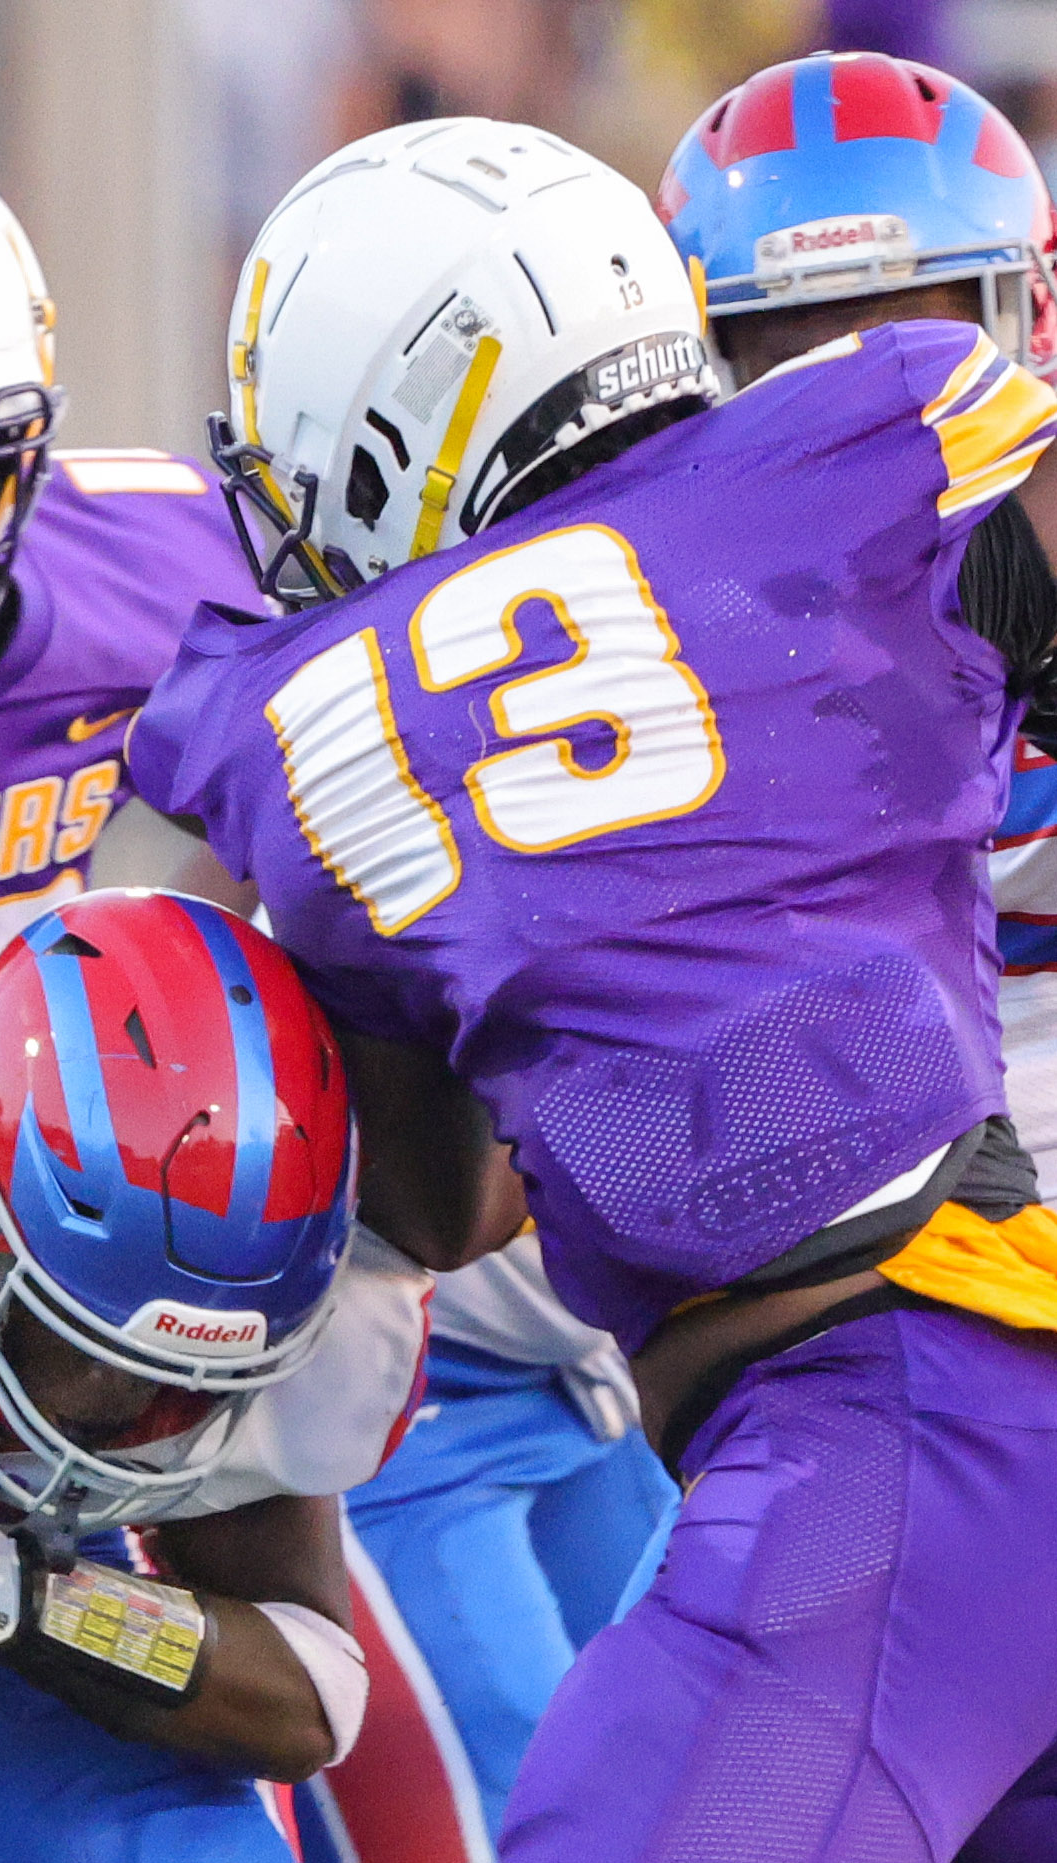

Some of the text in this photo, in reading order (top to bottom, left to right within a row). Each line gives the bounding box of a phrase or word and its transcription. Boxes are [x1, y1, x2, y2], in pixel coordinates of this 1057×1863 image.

[792, 221, 876, 252] Riddell
[618, 279, 645, 311] 13
[597, 335, 698, 401] schutt
[264, 521, 727, 938] 13
[155, 1312, 259, 1343] Riddell
